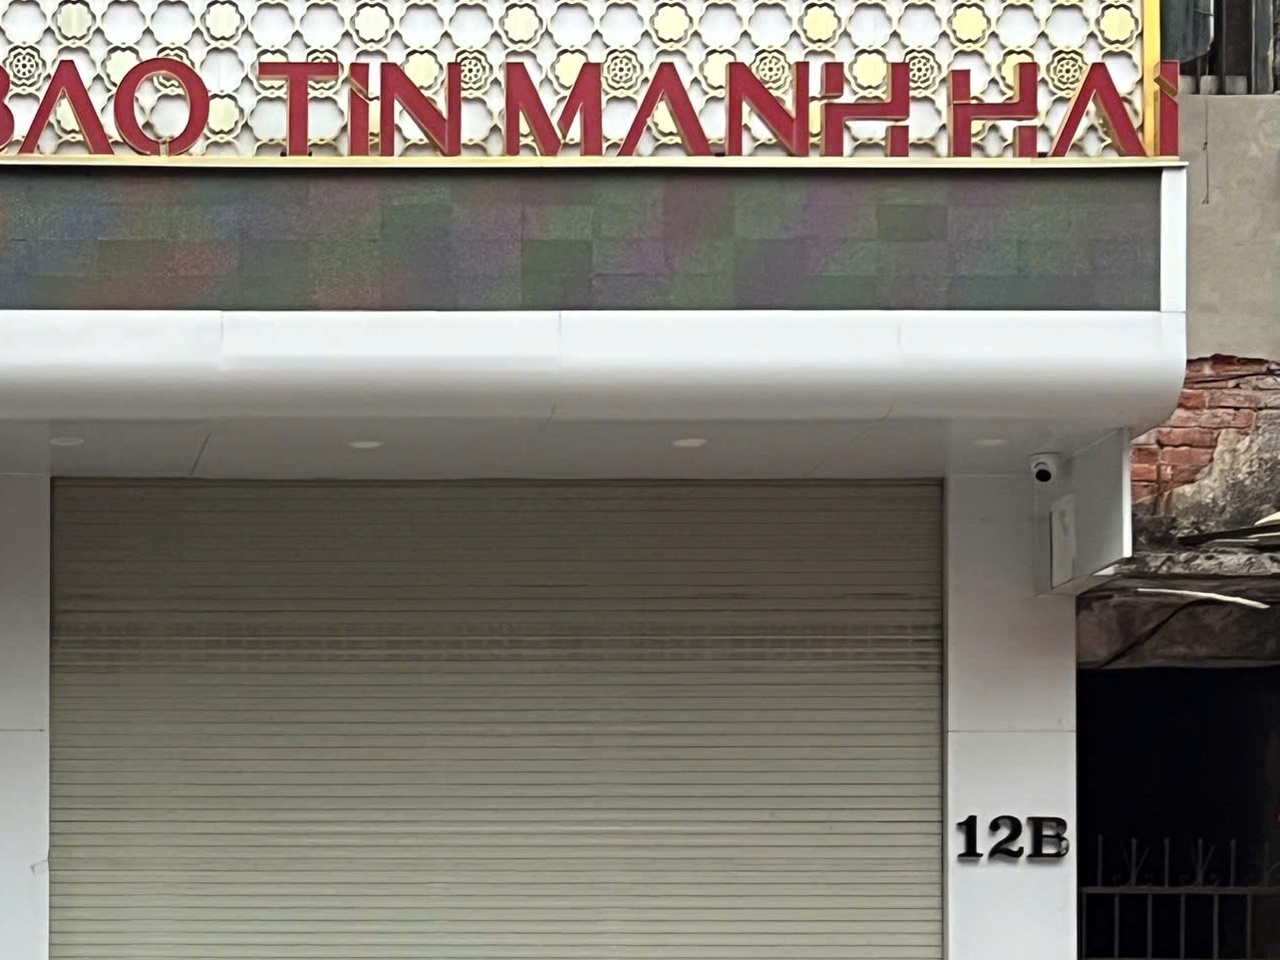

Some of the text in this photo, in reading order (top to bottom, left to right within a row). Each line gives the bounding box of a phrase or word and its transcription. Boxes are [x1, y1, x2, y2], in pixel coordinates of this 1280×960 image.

[258, 62, 462, 157] TIN
[505, 62, 909, 157] MANH
[951, 61, 1180, 157] HAI
[956, 814, 1070, 859] 12B
